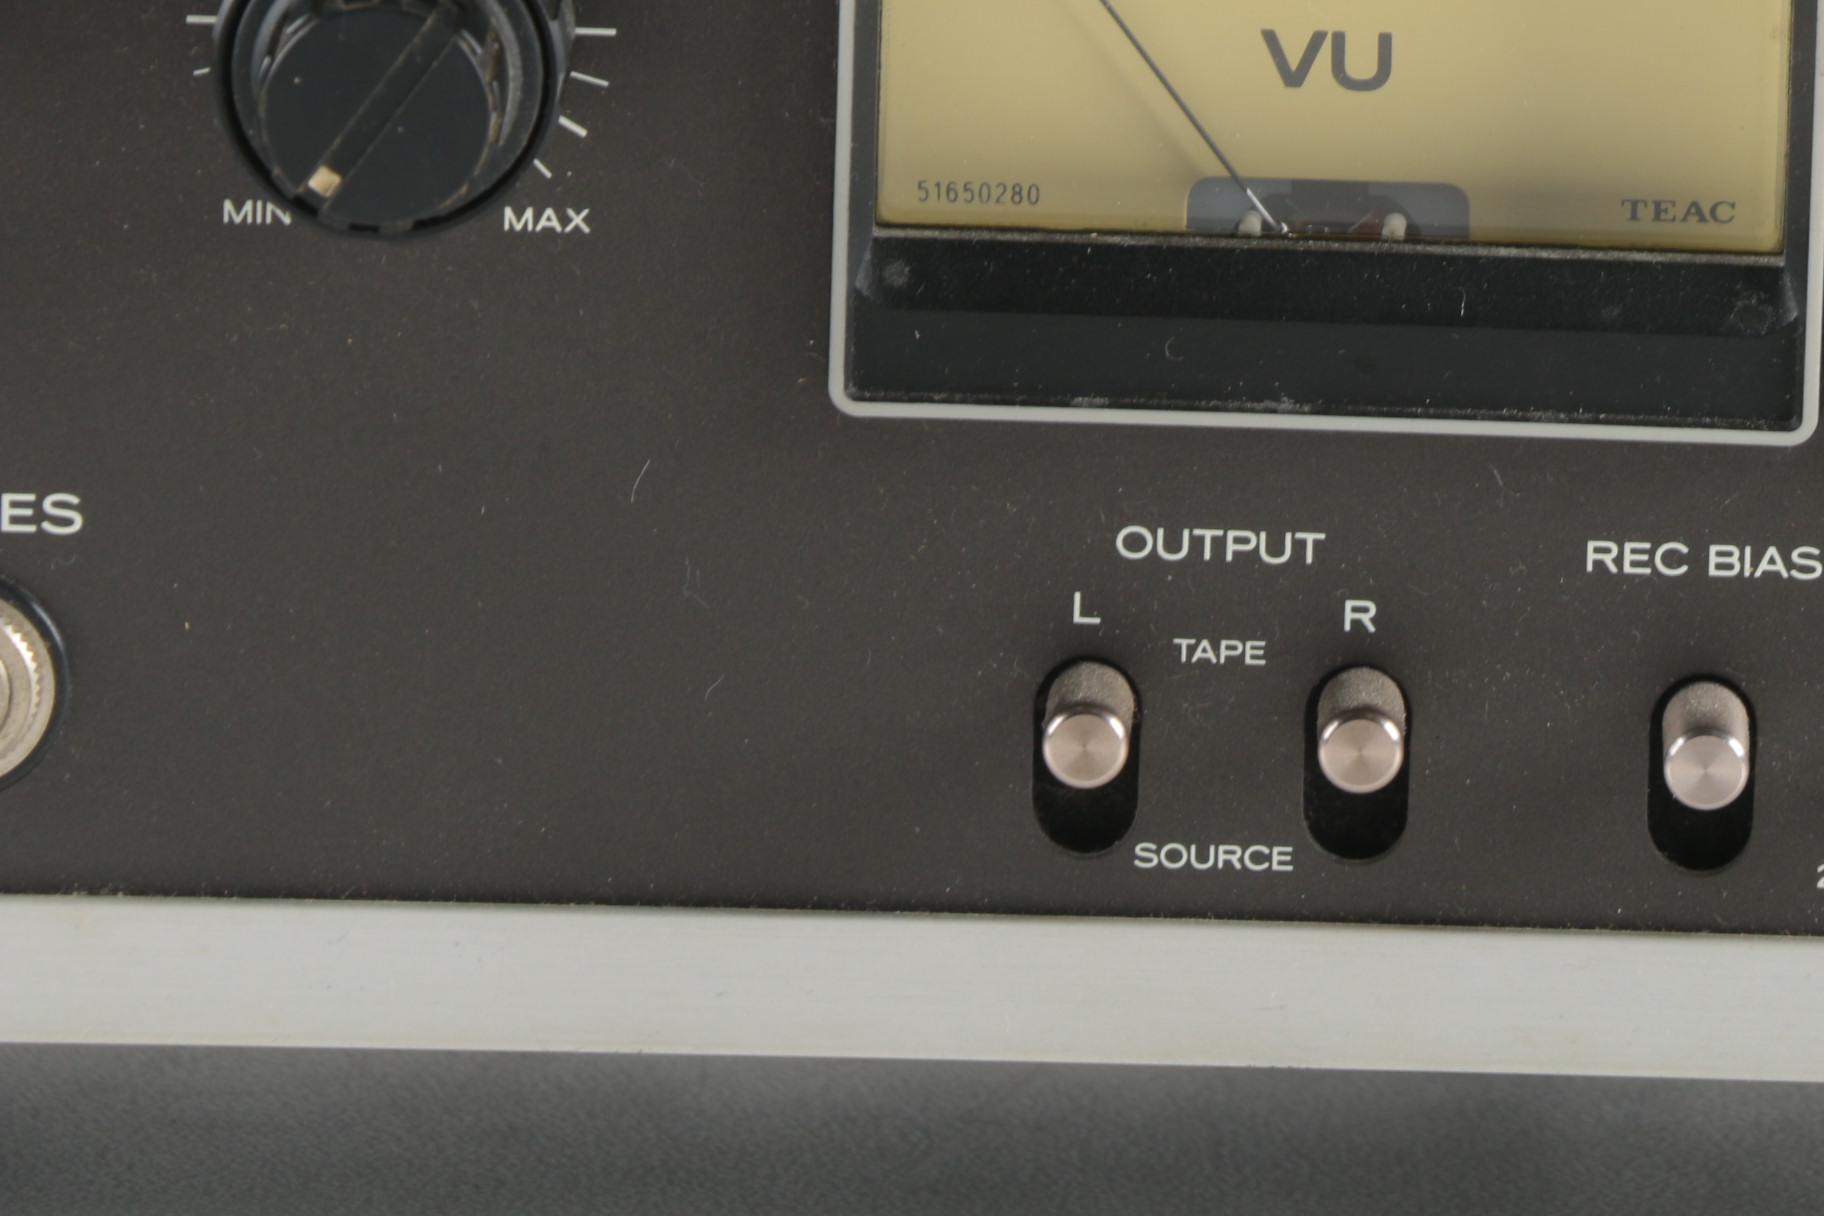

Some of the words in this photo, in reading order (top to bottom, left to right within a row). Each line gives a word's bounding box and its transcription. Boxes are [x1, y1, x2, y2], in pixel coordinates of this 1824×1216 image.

[1260, 28, 1394, 92] VU
[915, 179, 1042, 207] 51650280
[222, 198, 292, 226] MIN
[503, 205, 592, 234] MAX
[1620, 196, 1738, 225] TEAC
[0, 491, 84, 535] ES
[1115, 525, 1326, 565] OUTPUT
[1586, 540, 1690, 578] REC
[1708, 545, 1824, 581] BIAS
[1072, 591, 1101, 625] L
[1343, 599, 1377, 633] R
[1173, 638, 1267, 666] TAPE
[1134, 843, 1294, 872] SOURCE
